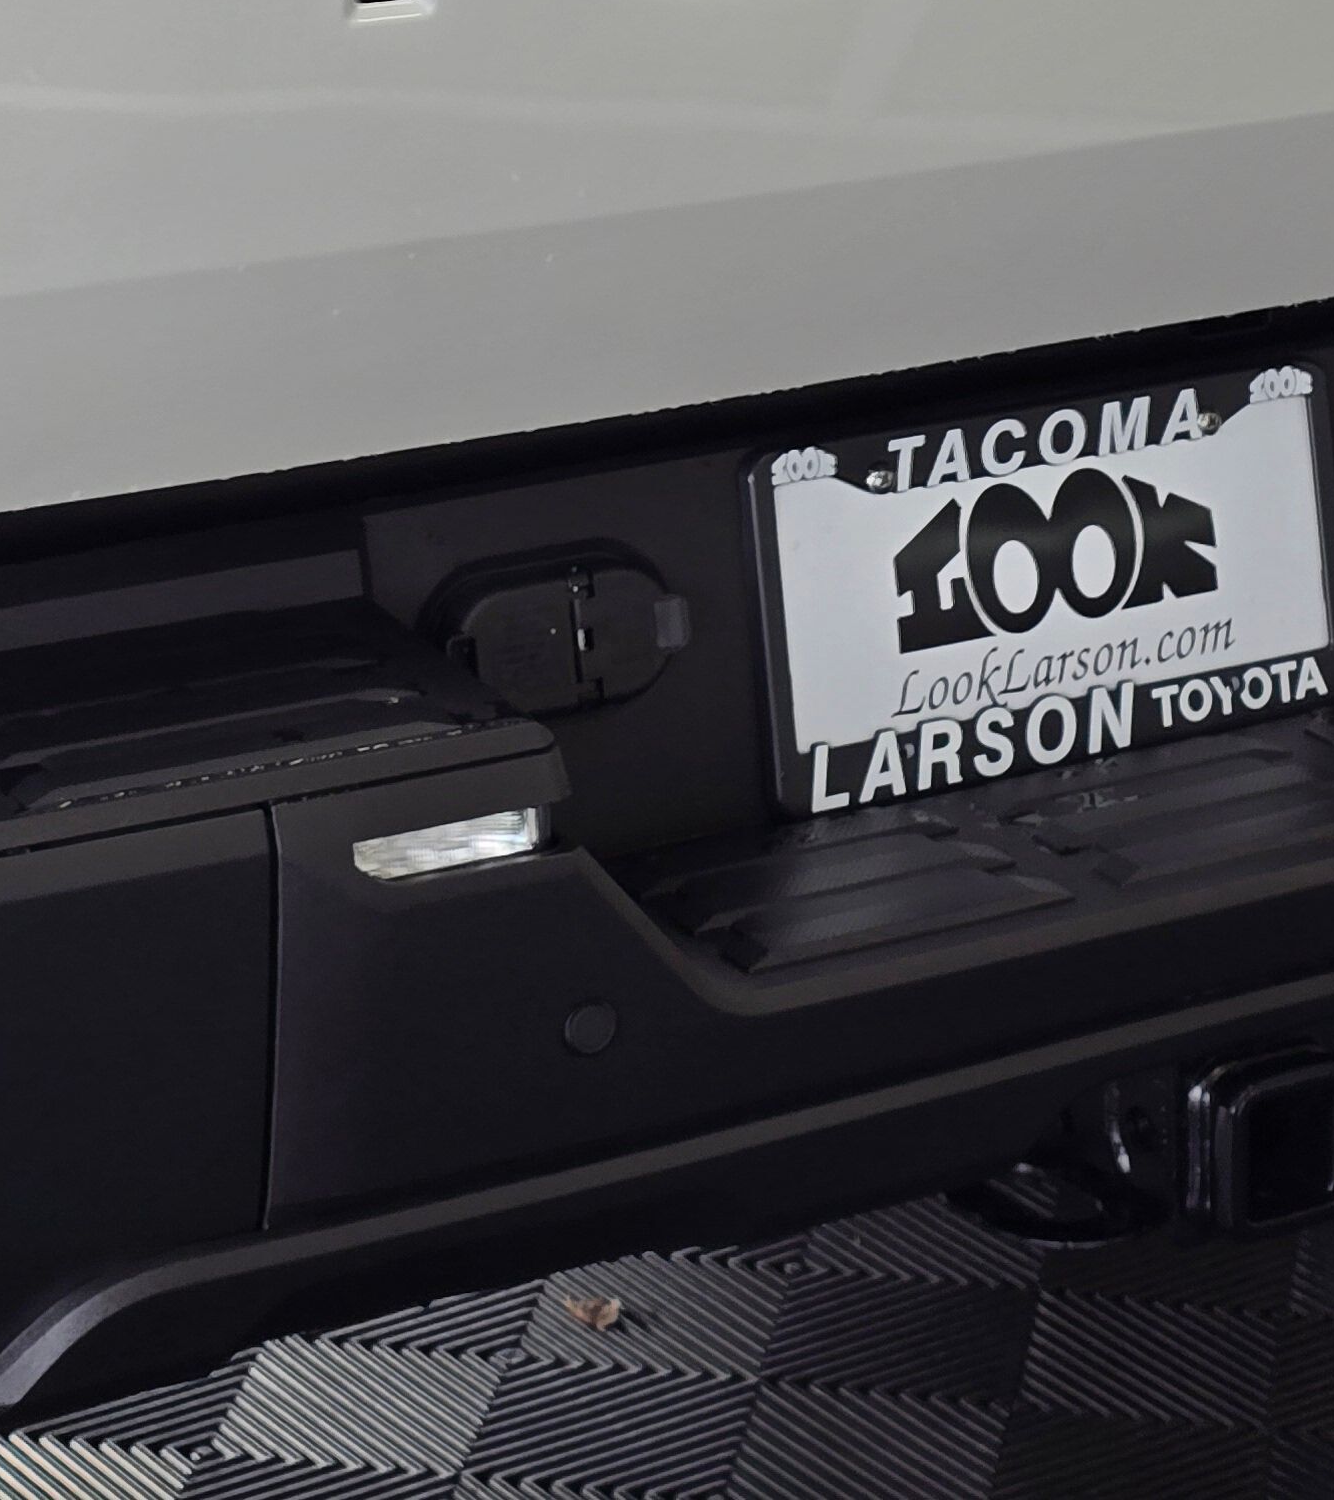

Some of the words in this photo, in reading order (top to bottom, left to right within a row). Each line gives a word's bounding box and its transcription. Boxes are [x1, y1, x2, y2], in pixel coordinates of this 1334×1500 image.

[887, 388, 1205, 493] TACOMA
[893, 467, 1219, 654] LOOK
[891, 615, 1237, 718] LookLarson.com
[810, 680, 1136, 814] LARSON
[1151, 656, 1329, 728] TOYOTA
